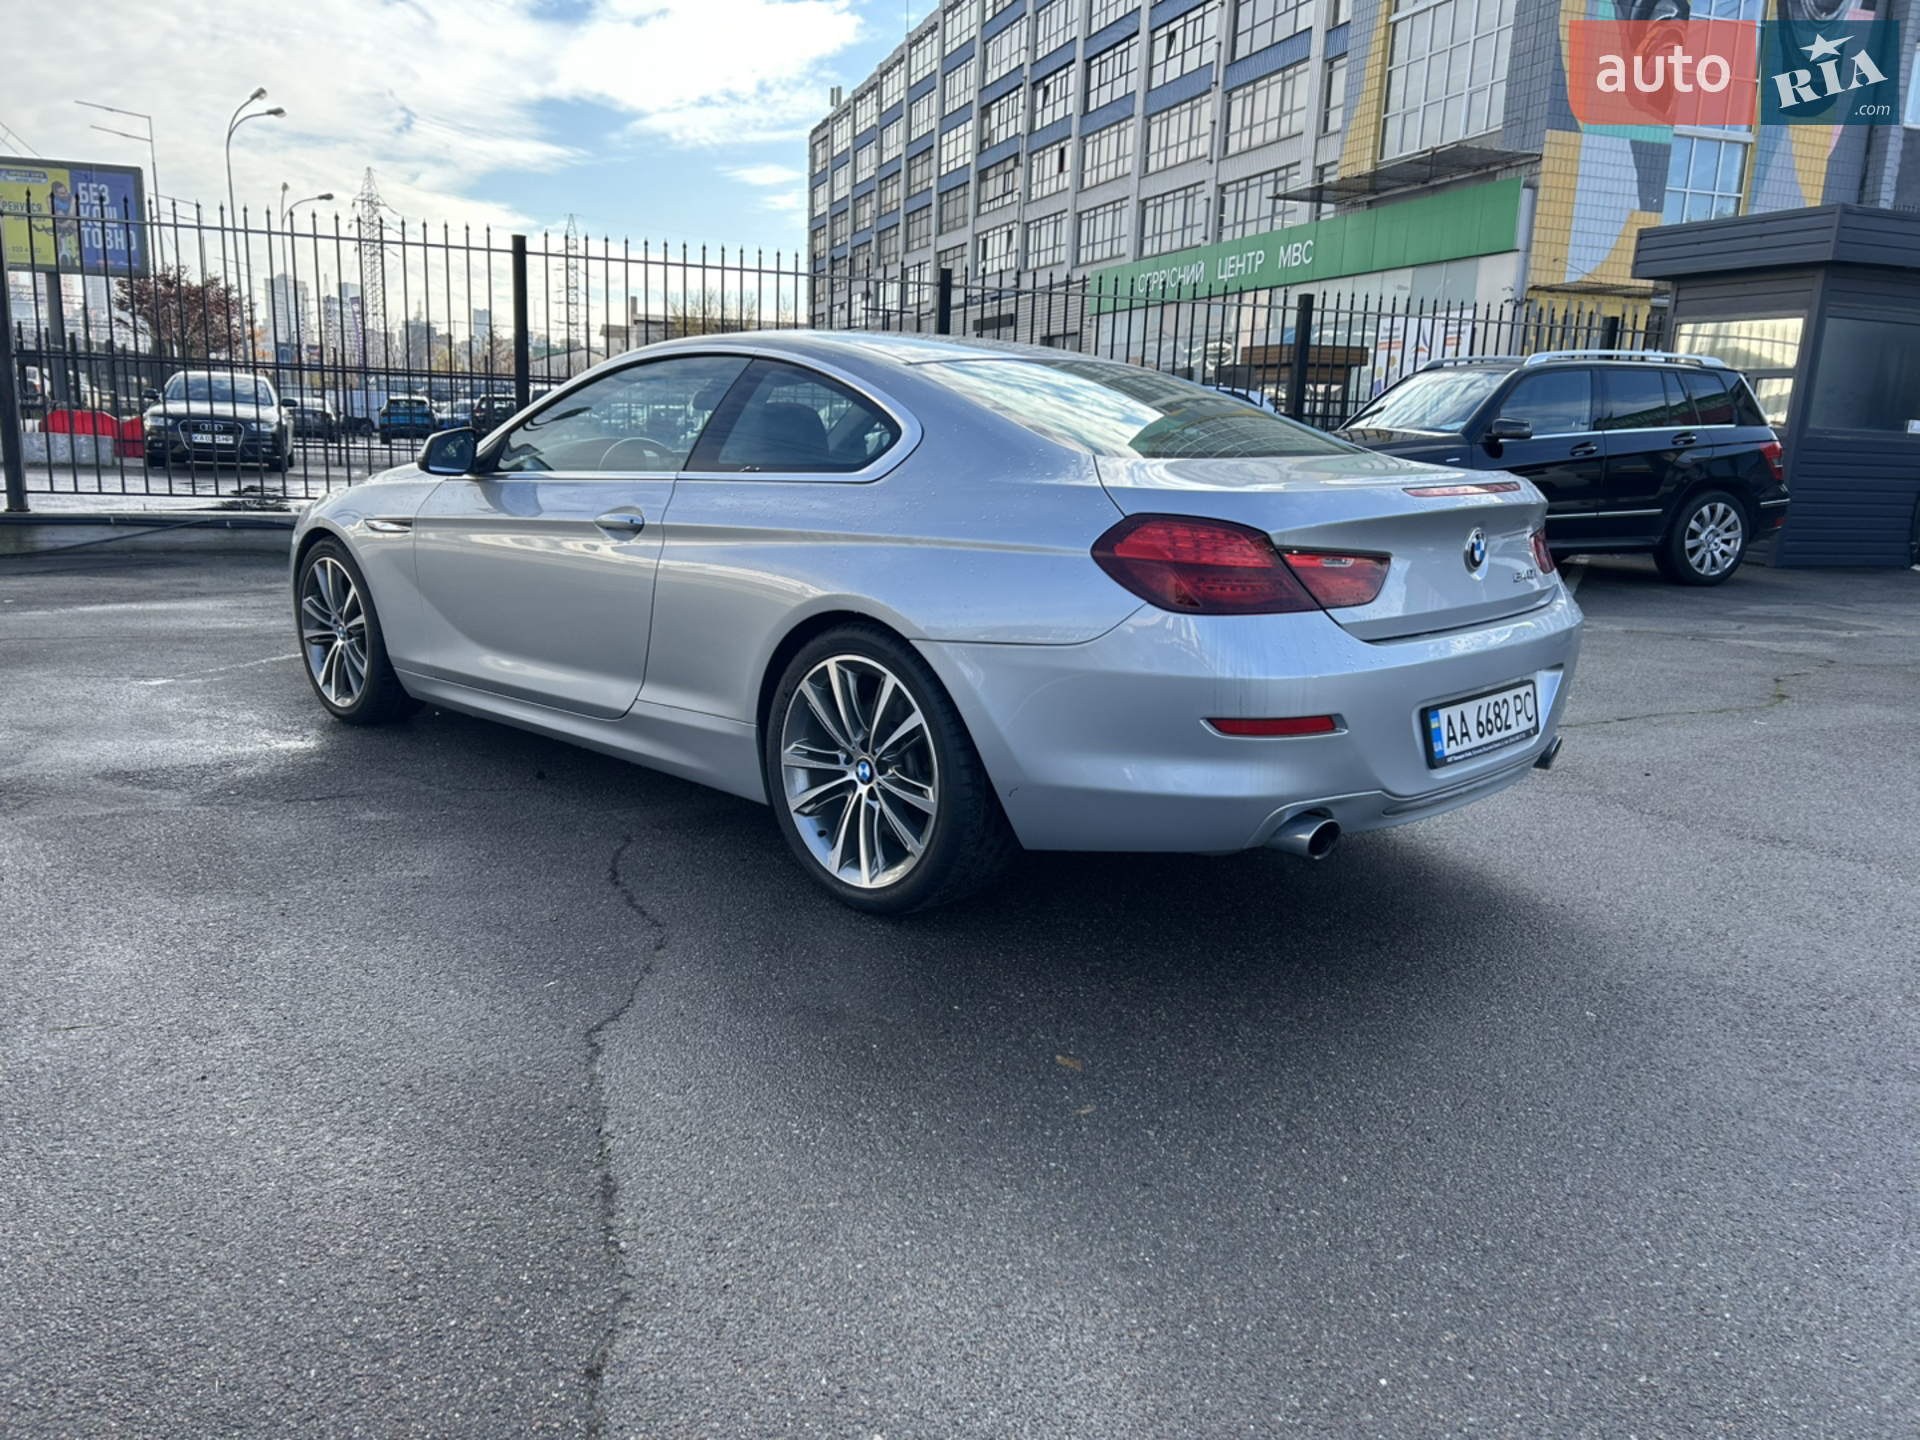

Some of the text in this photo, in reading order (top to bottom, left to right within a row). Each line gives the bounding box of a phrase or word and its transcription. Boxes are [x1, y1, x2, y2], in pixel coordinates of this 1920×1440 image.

[78, 182, 110, 205] БЕЗ
[2, 200, 43, 213] РЕНУСЯ
[79, 204, 118, 227] КОШ
[81, 227, 137, 251] ТОВНО
[1217, 250, 1265, 281] ЦЕНТР
[1278, 240, 1314, 269] МВС
[1446, 710, 1472, 749] AA
[1476, 697, 1512, 739] 6682
[1513, 690, 1534, 727] PC
